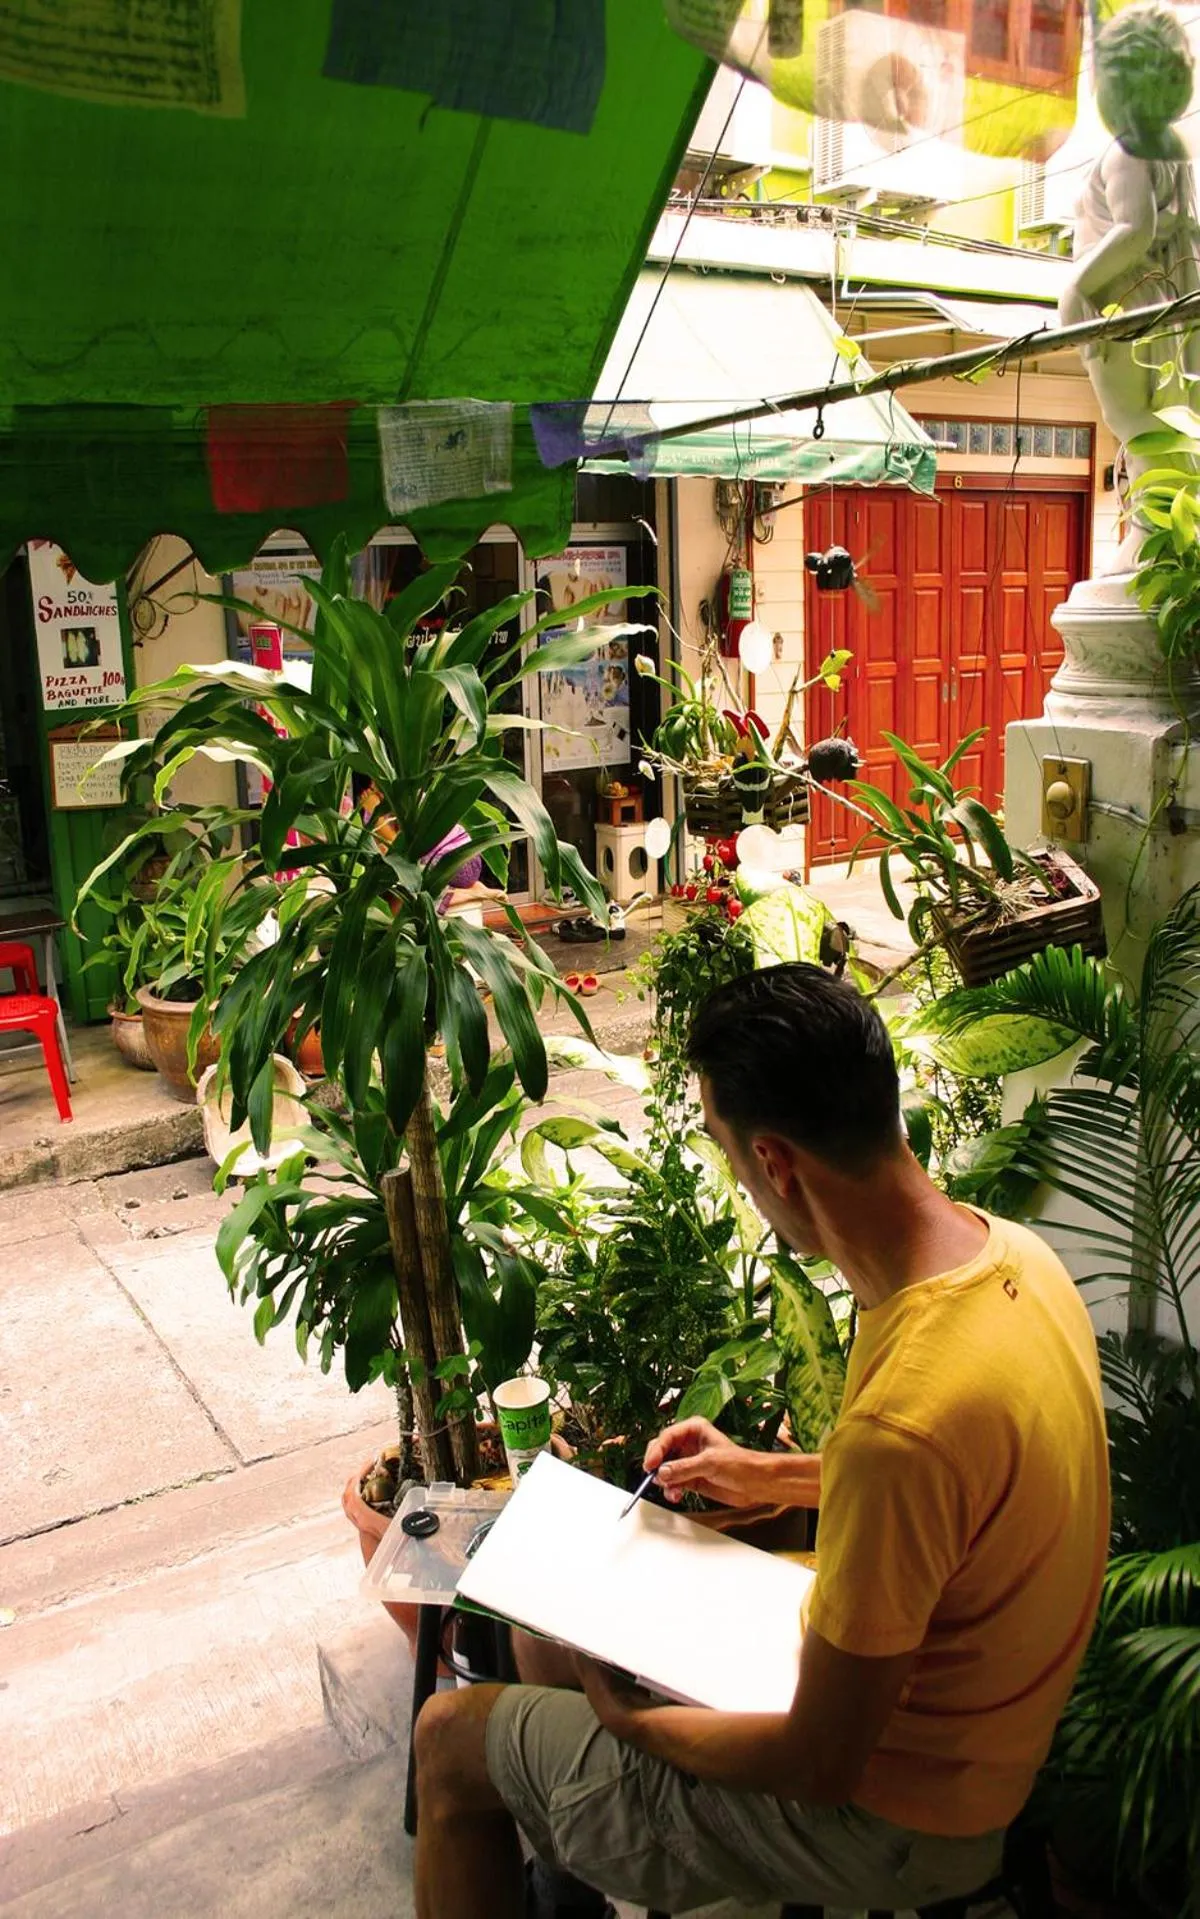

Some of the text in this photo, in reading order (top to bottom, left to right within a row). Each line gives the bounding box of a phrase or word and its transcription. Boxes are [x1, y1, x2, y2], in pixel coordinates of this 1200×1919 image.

[954, 475, 963, 489] 6
[38, 595, 118, 623] SANDWICHES
[46, 675, 88, 687] PIZZA
[47, 686, 103, 701] BAGUETTE
[58, 699, 78, 708] AND
